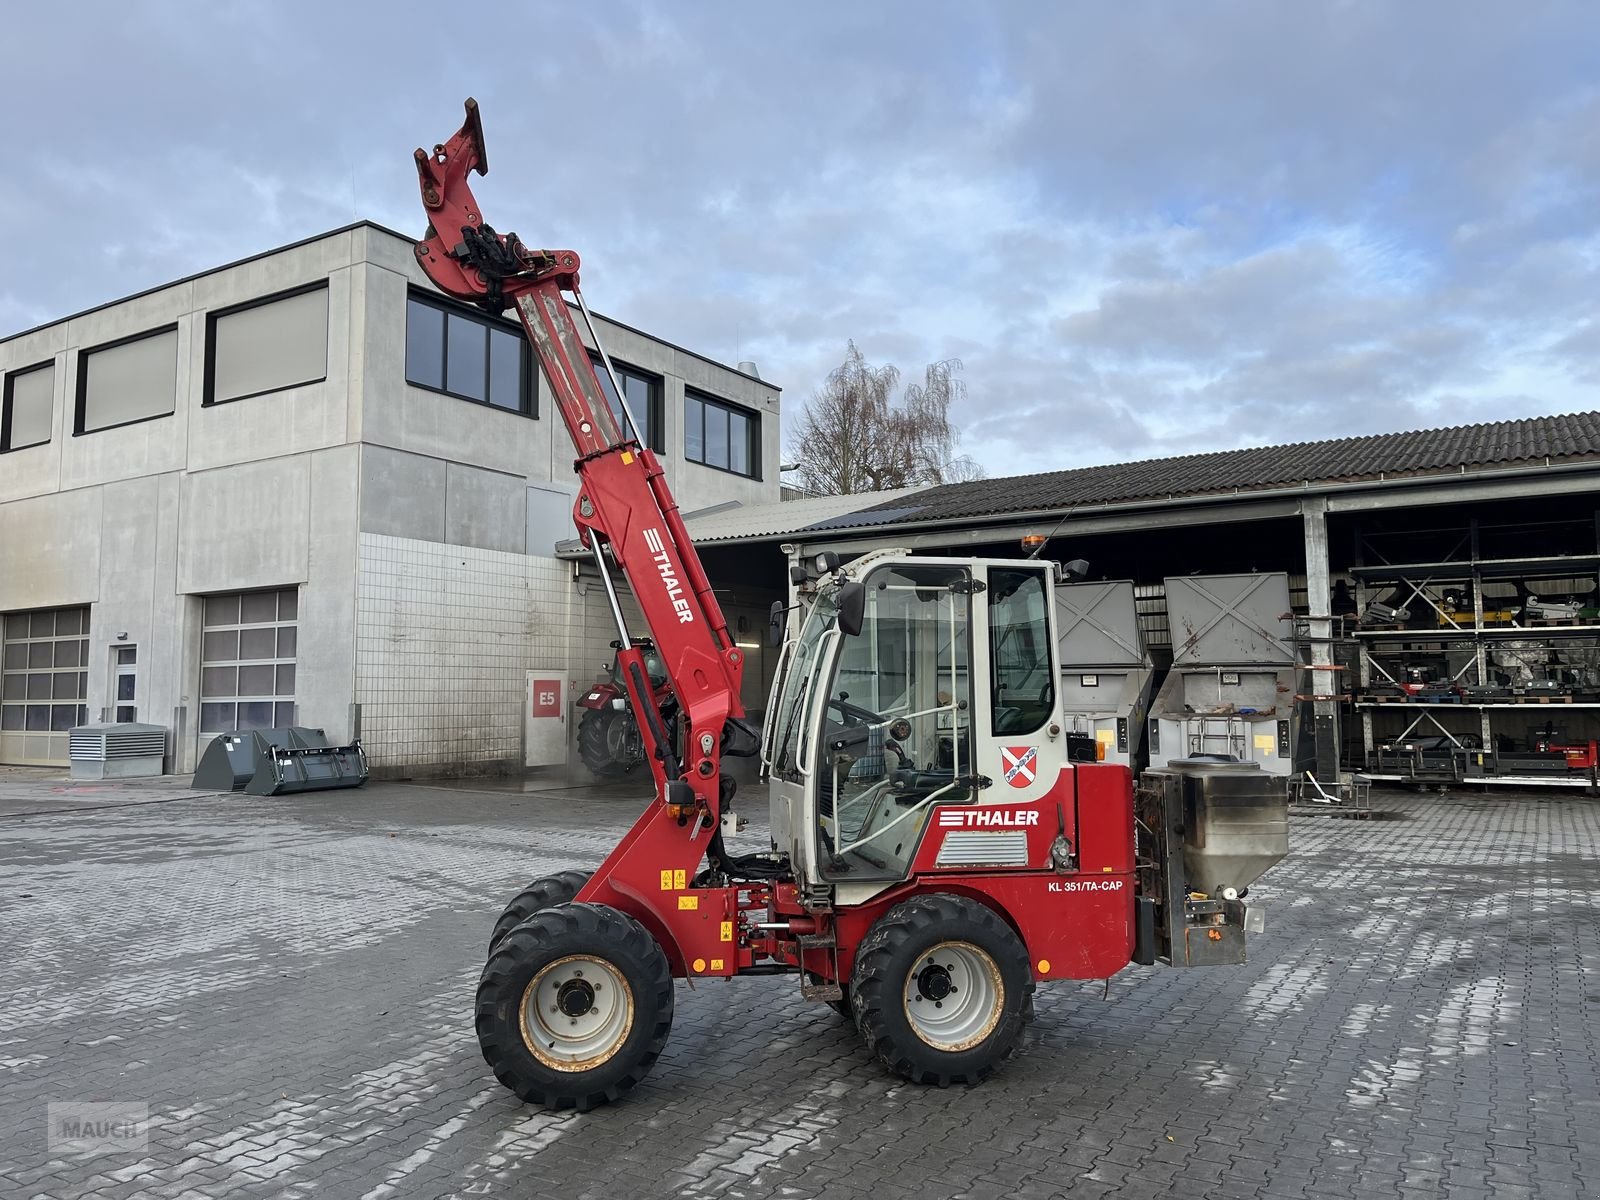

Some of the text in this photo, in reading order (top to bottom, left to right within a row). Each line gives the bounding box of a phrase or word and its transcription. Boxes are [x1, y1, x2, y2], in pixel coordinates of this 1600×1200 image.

[653, 546, 694, 624] THALER
[539, 691, 555, 706] E5
[964, 811, 1039, 826] THALER
[1048, 881, 1123, 892] KL 351/TA-CAP
